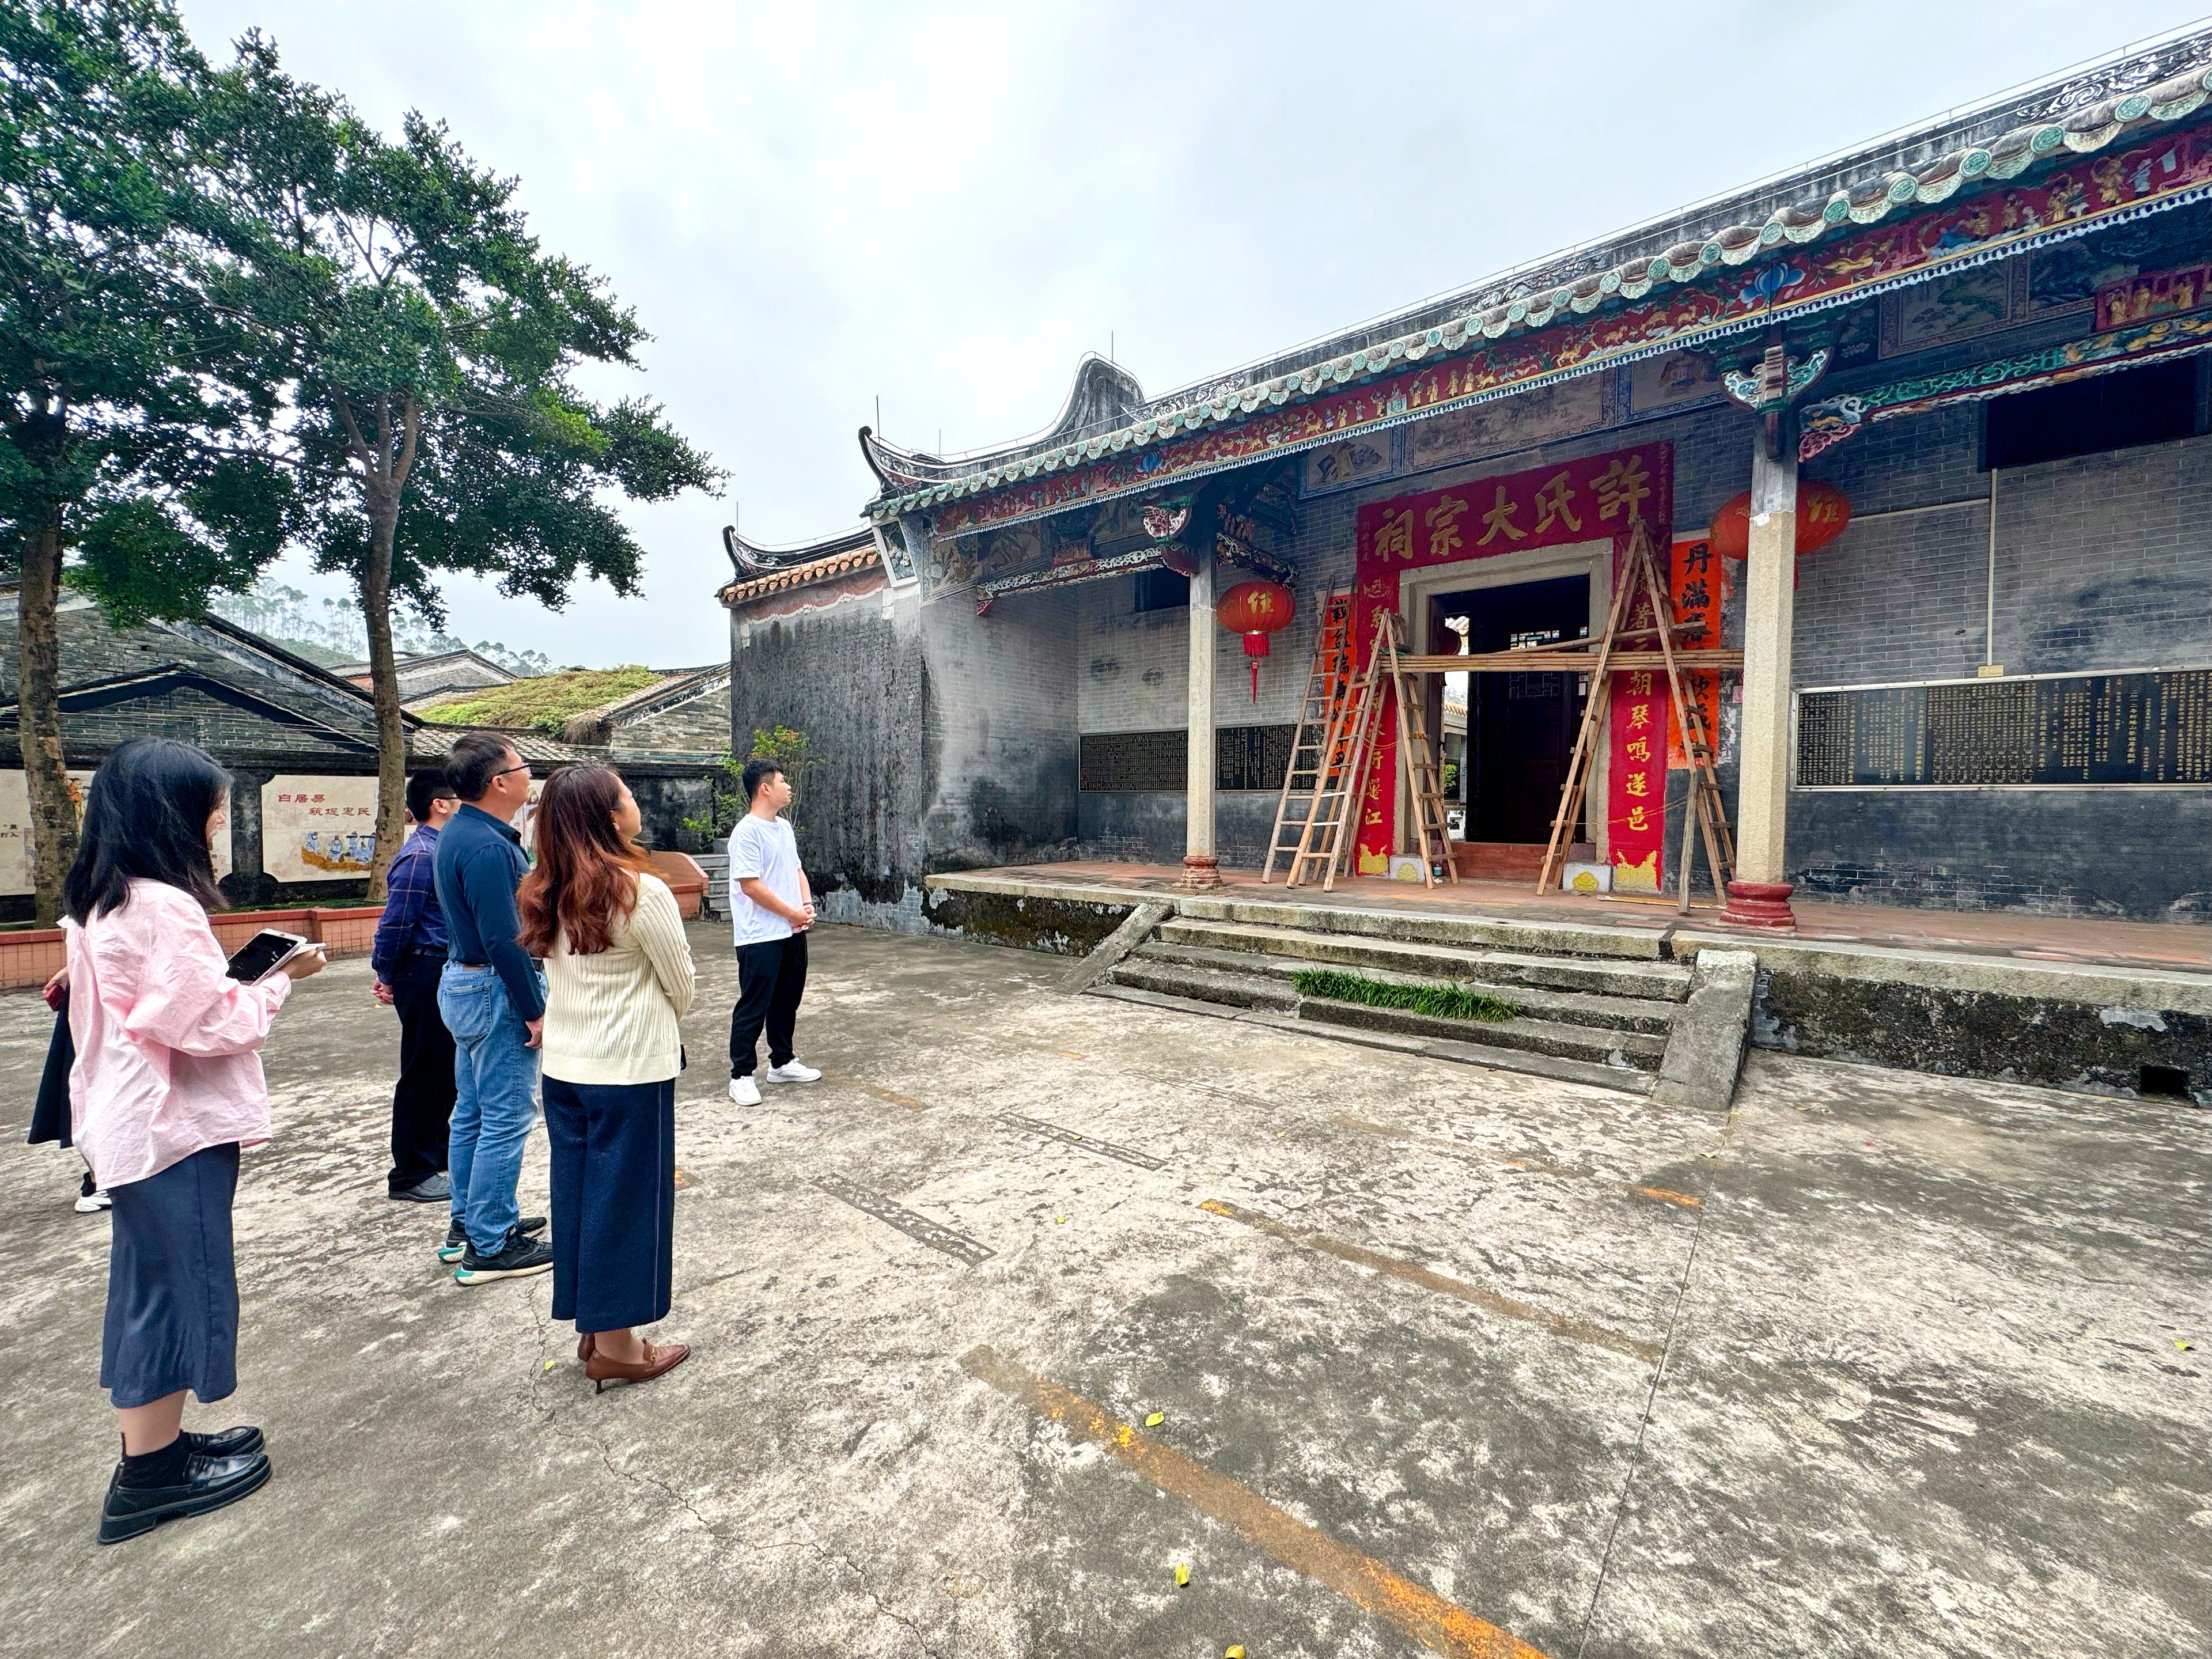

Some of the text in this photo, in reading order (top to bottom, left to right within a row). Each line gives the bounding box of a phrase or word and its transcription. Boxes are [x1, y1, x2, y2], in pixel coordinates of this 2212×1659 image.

[1374, 455, 1652, 562] 許氏大宗祠
[1247, 590, 1275, 615] 佳
[278, 794, 325, 803] 白居易
[309, 807, 372, 816] 筑堤惠民
